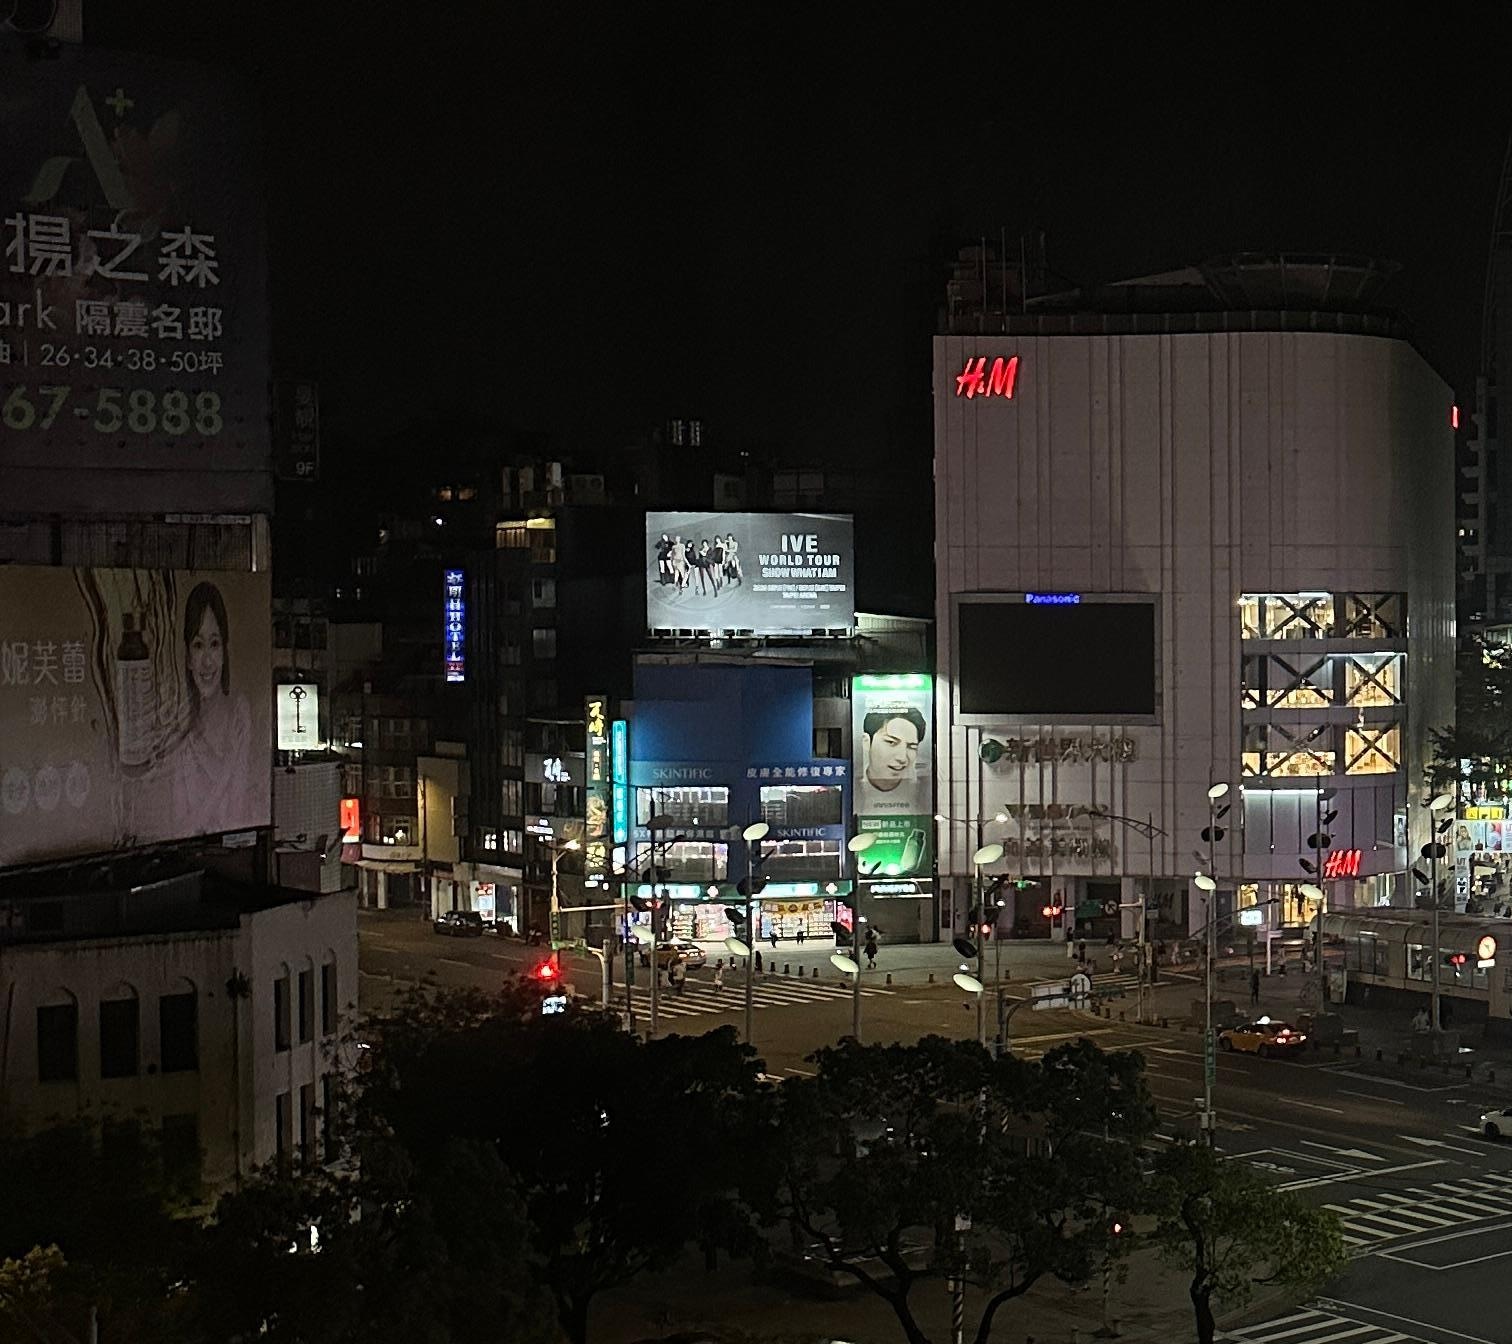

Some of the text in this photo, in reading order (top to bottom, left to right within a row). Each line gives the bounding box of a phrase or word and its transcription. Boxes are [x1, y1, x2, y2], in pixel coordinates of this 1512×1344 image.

[956, 356, 1018, 399] H&M
[782, 534, 818, 552] IVE
[759, 555, 840, 566] WORLD TOUR
[1025, 592, 1080, 604] Panasonic
[652, 767, 713, 780] SKINTIFIC
[777, 828, 827, 838] SKINTIFIC
